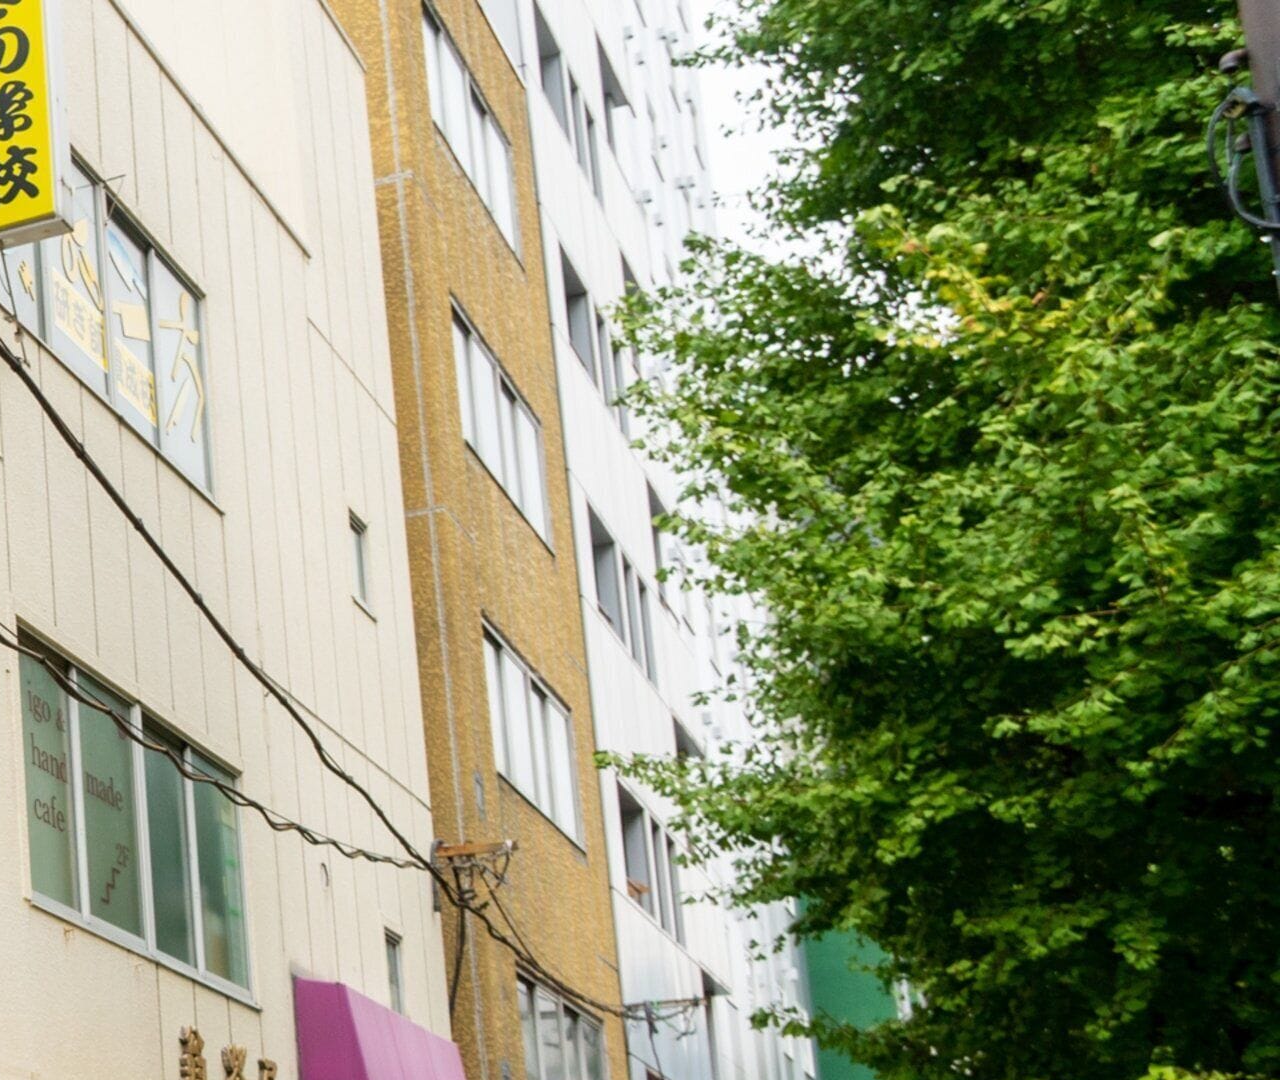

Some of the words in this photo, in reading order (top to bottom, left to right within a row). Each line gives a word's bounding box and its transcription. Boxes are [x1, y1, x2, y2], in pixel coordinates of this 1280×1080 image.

[26, 689, 52, 724] igo
[30, 732, 69, 784] hand
[84, 770, 123, 811] made
[33, 796, 66, 833] cafe
